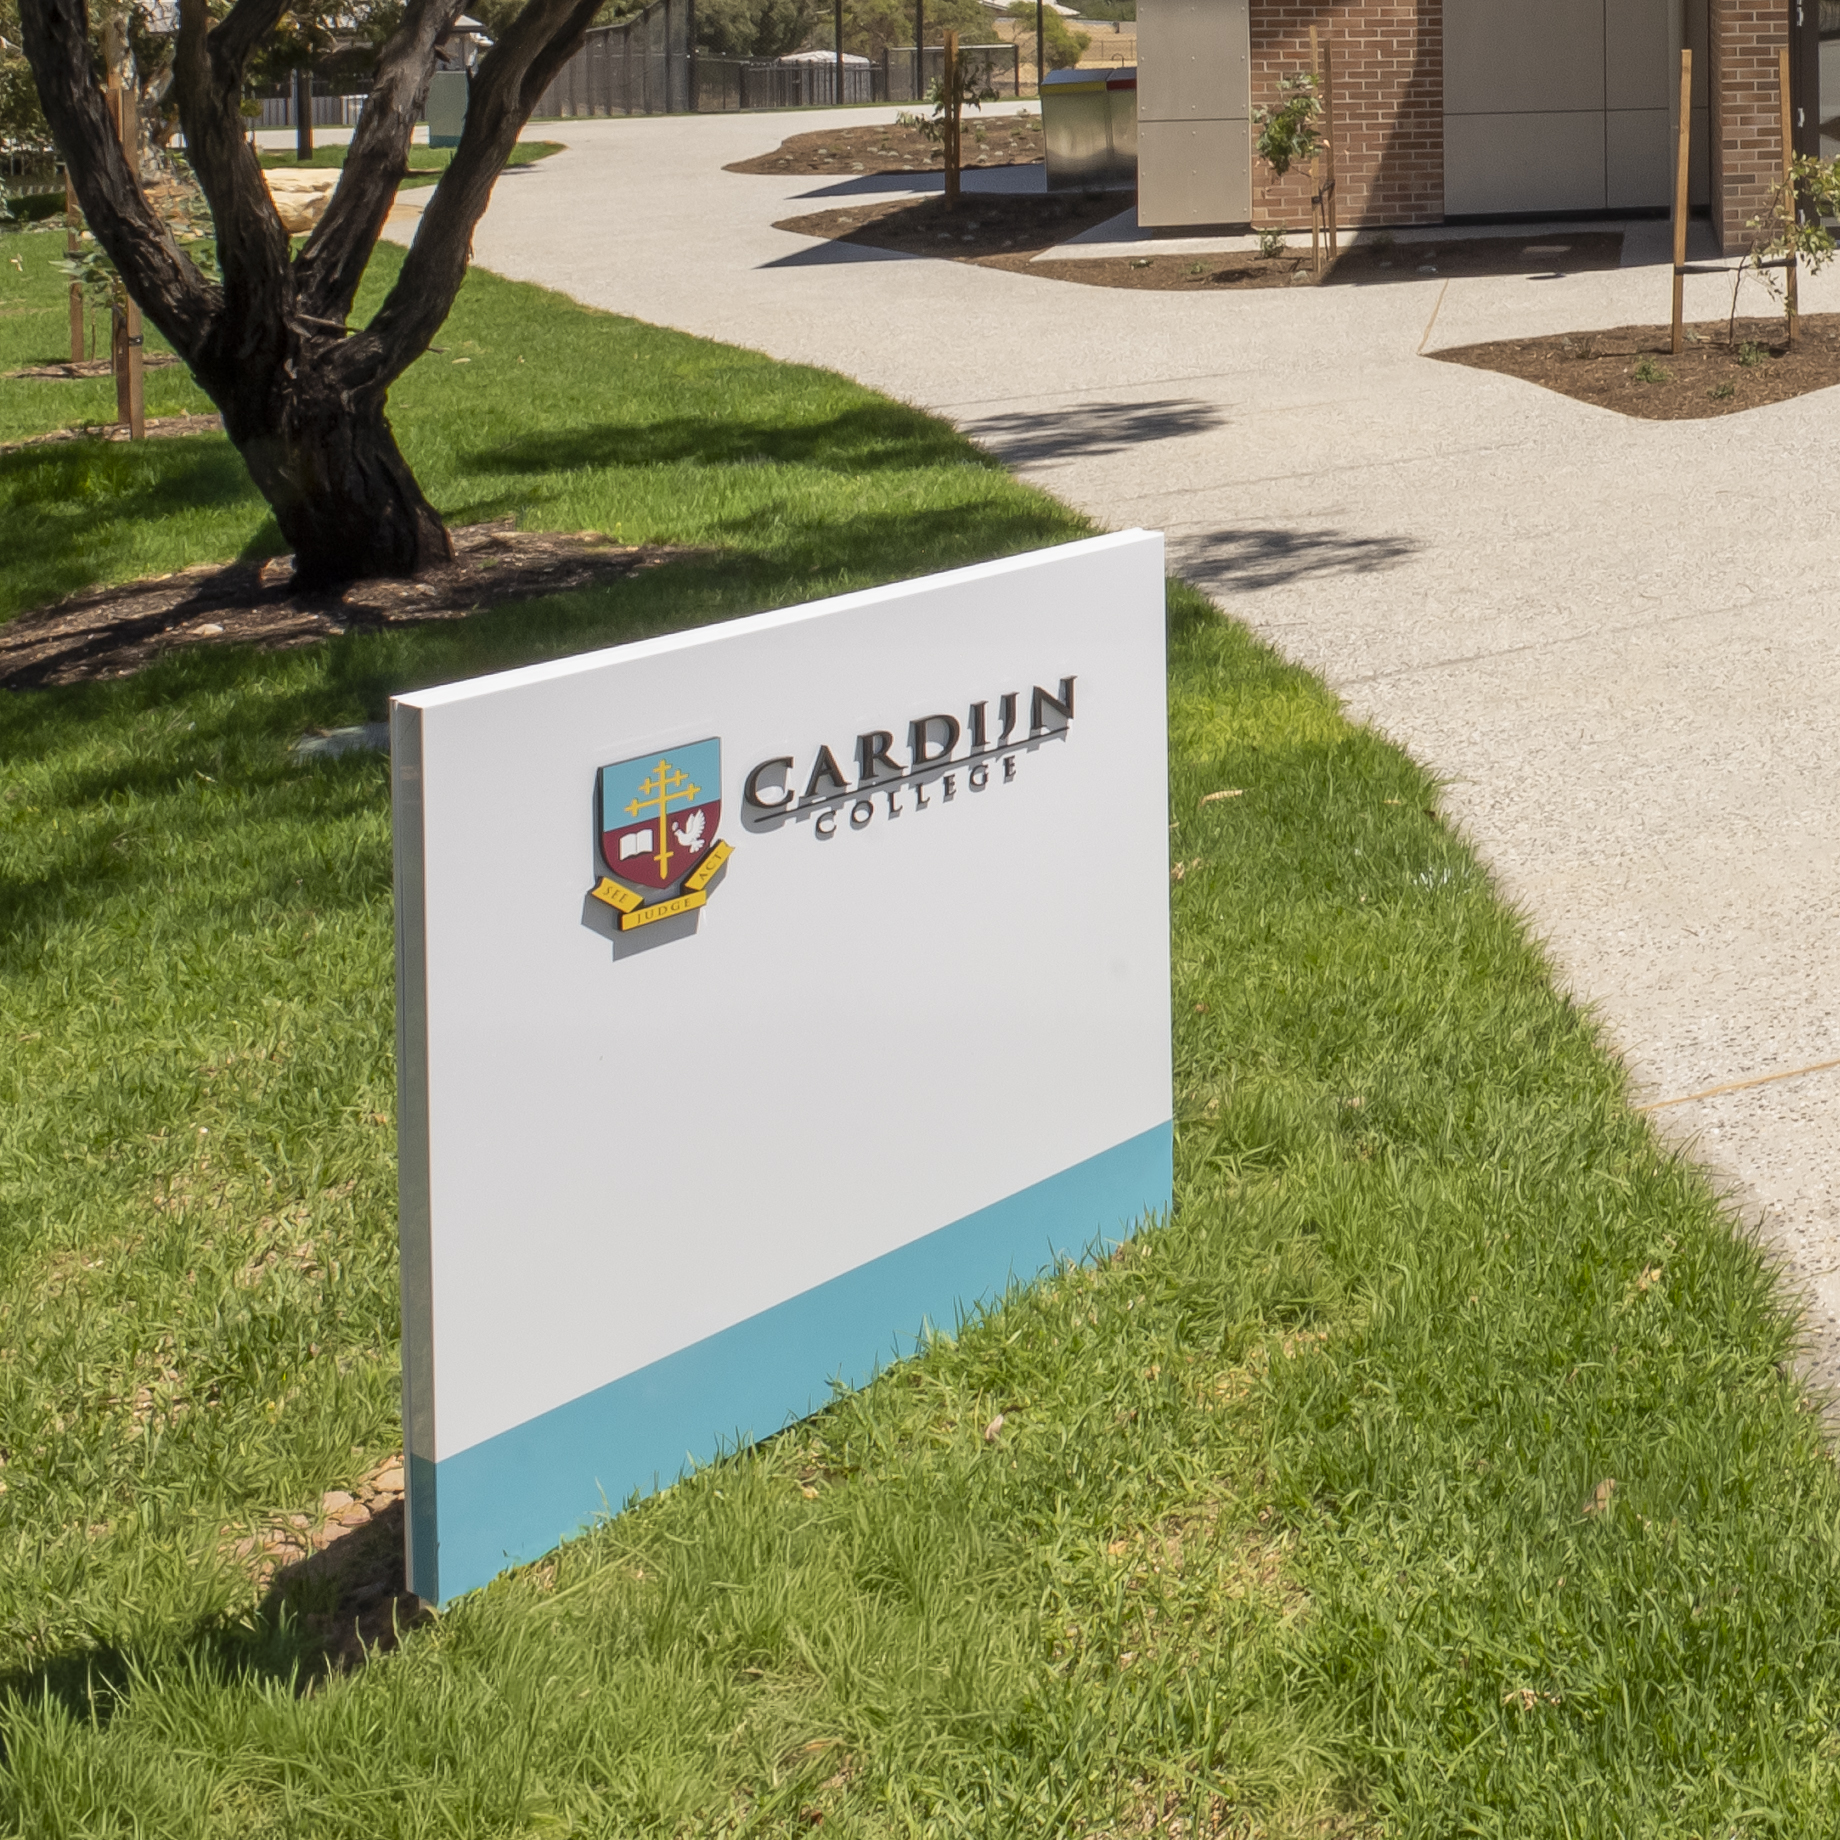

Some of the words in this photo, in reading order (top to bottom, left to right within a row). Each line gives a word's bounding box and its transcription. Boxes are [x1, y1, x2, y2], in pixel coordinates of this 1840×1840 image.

[743, 675, 1078, 808] CARDIJN
[816, 755, 1016, 833] COLLEGE
[698, 851, 722, 881] ACT
[602, 886, 629, 903] SEE
[637, 898, 692, 924] JUDGE
